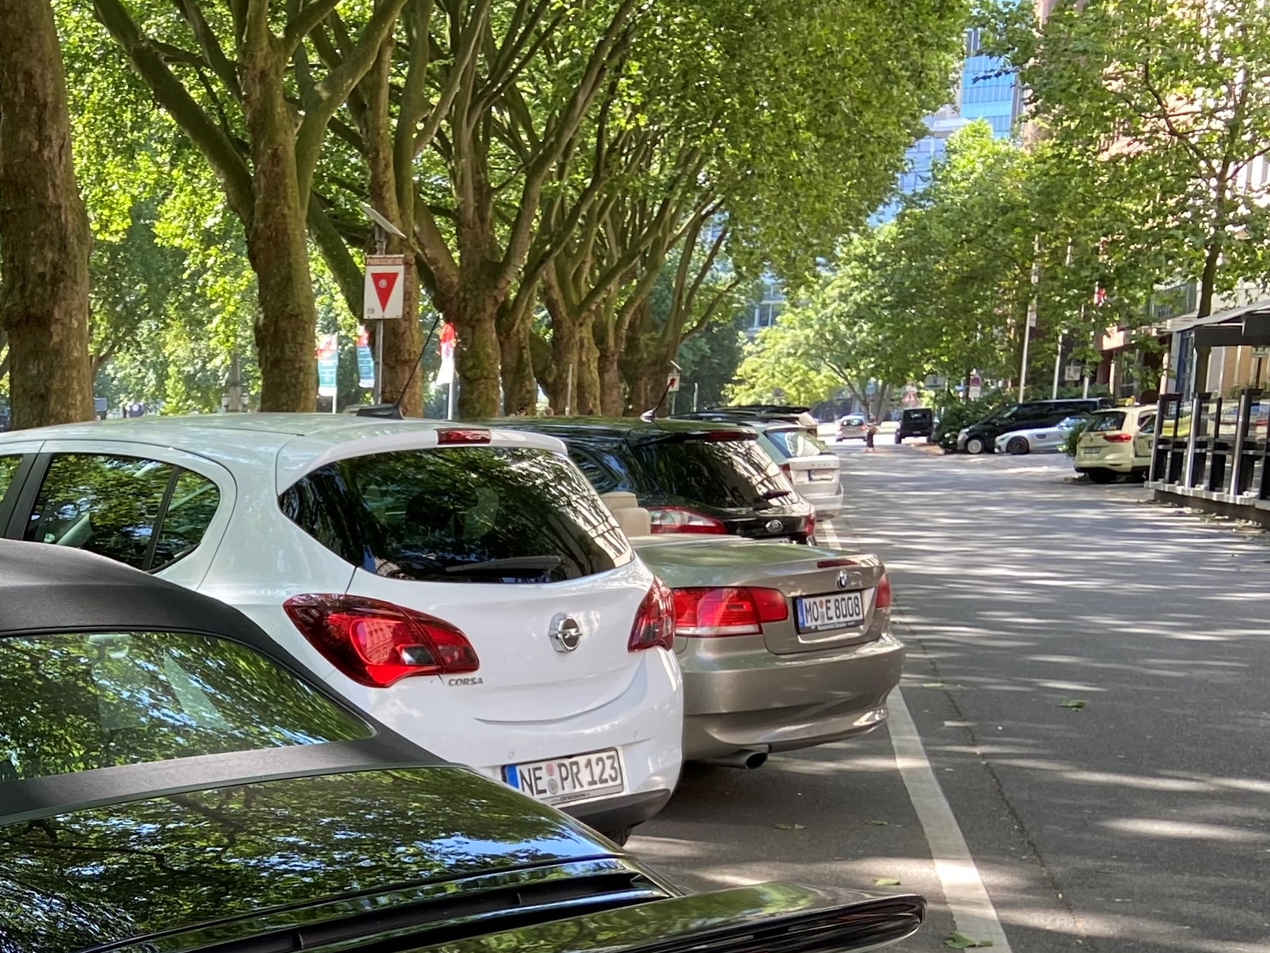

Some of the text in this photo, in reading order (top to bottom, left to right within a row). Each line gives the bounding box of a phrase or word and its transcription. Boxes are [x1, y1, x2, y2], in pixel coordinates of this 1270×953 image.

[804, 596, 861, 624] MO E 8008
[448, 677, 483, 686] CORSA
[519, 755, 619, 796] NE PR 123
